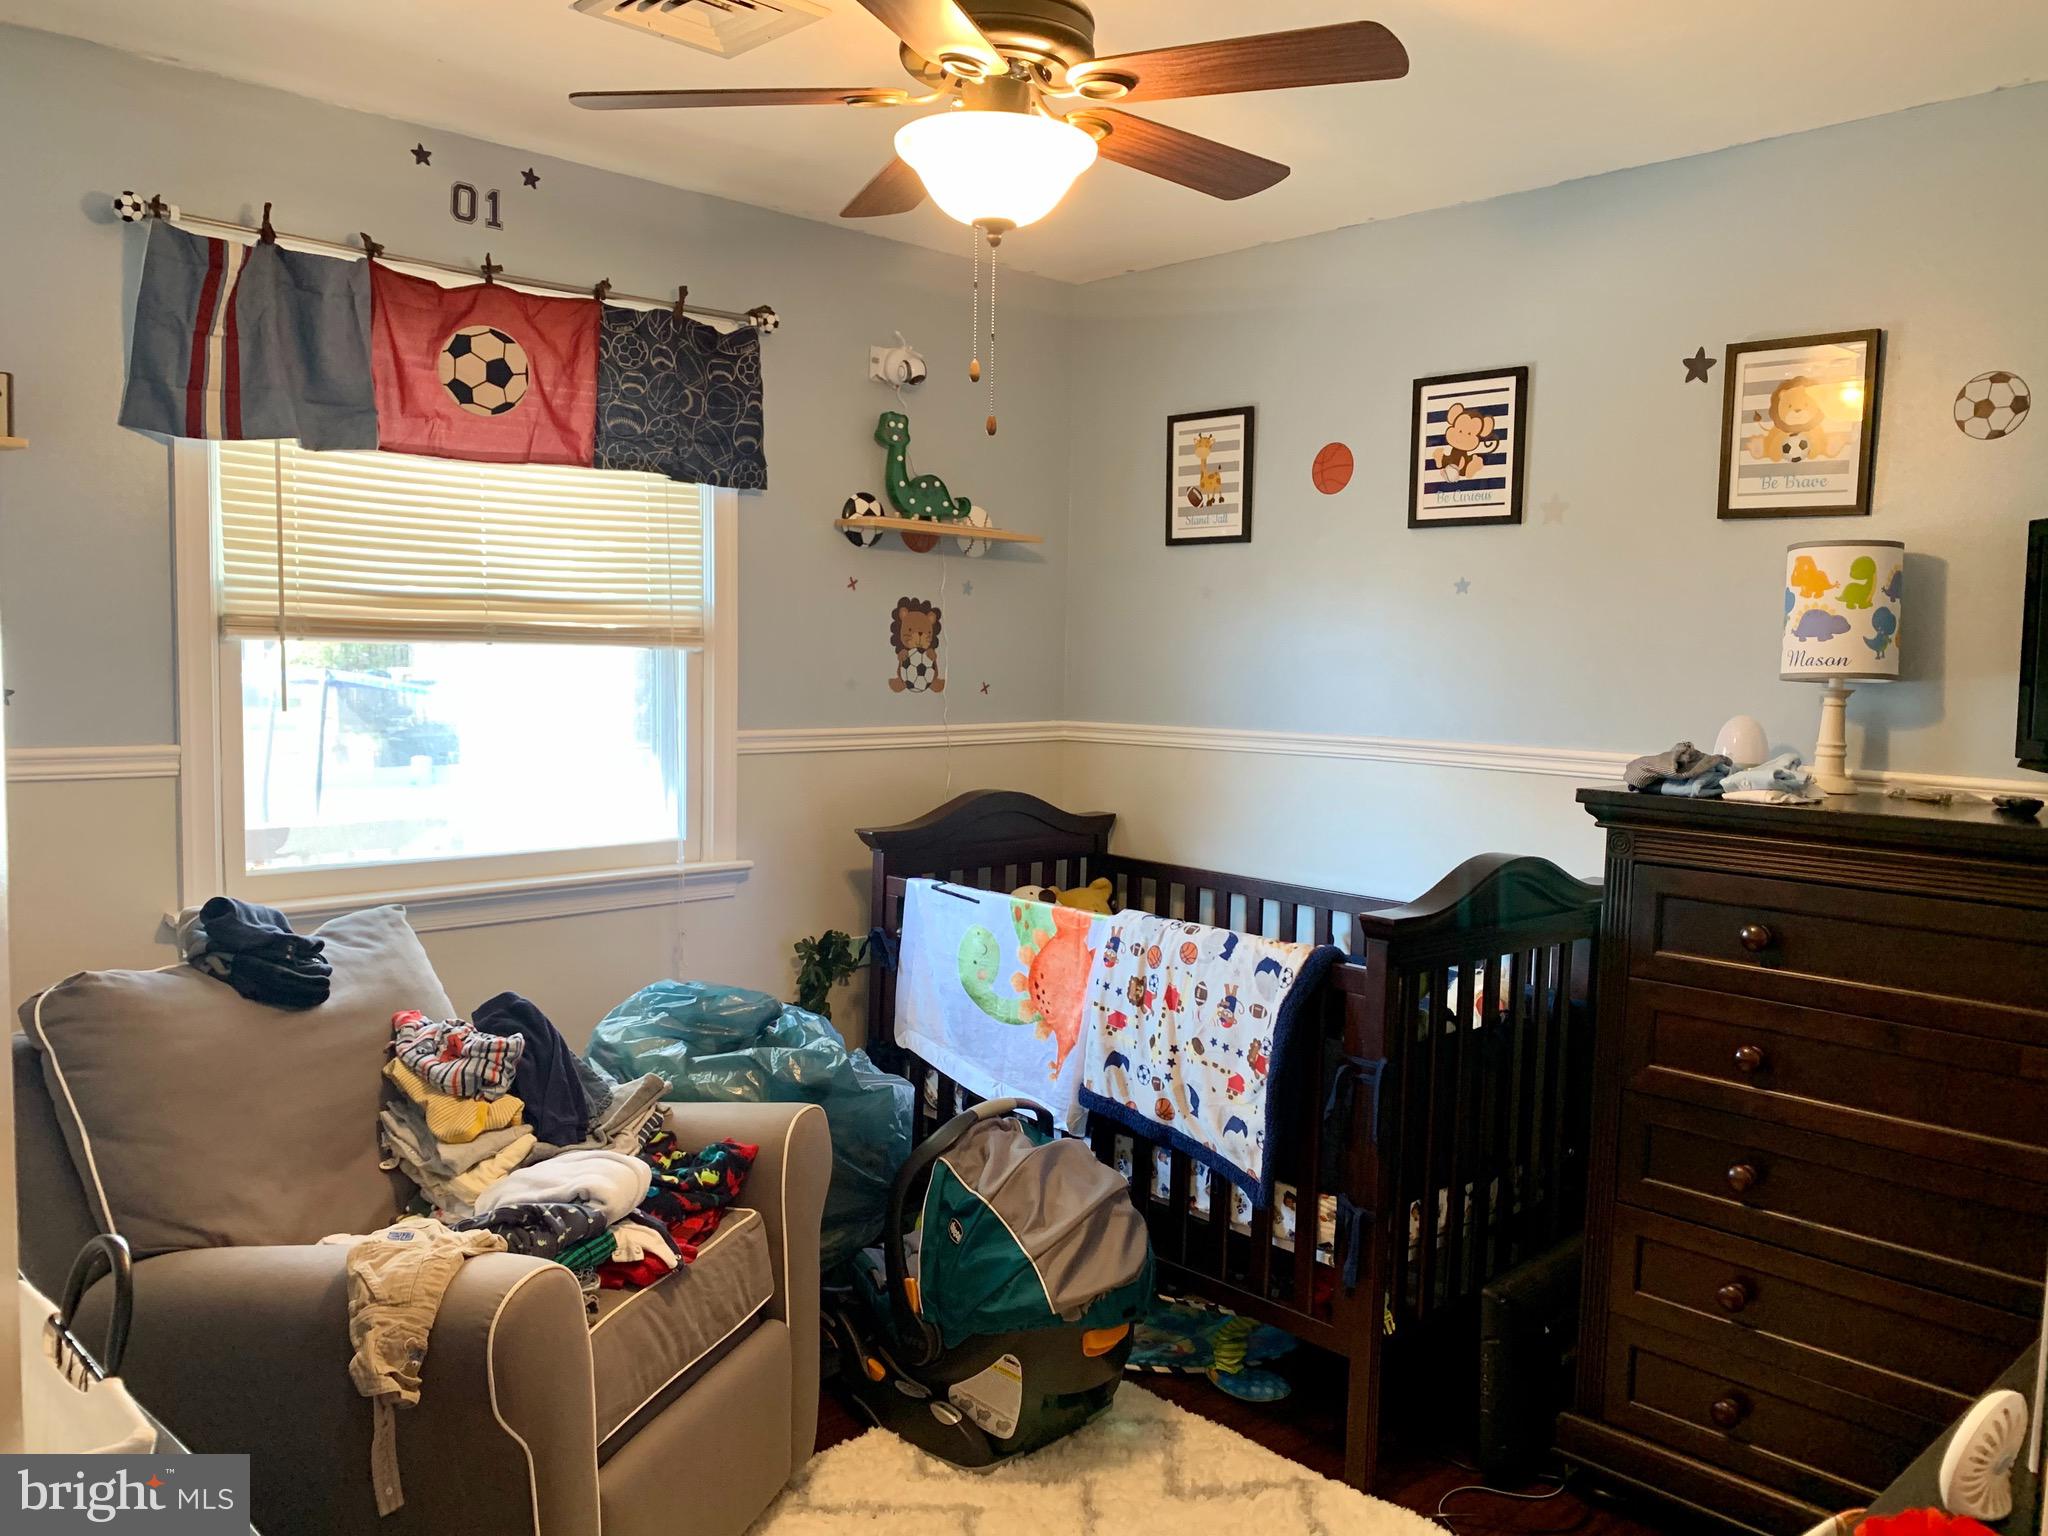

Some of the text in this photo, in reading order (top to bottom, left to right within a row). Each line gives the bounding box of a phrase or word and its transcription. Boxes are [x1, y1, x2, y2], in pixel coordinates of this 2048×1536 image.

[450, 181, 503, 231] 01
[1760, 473, 1828, 490] Be Brave
[1436, 490, 1494, 503] Be Curious
[1185, 512, 1228, 526] Stand Tall
[1787, 649, 1852, 667] Mason
